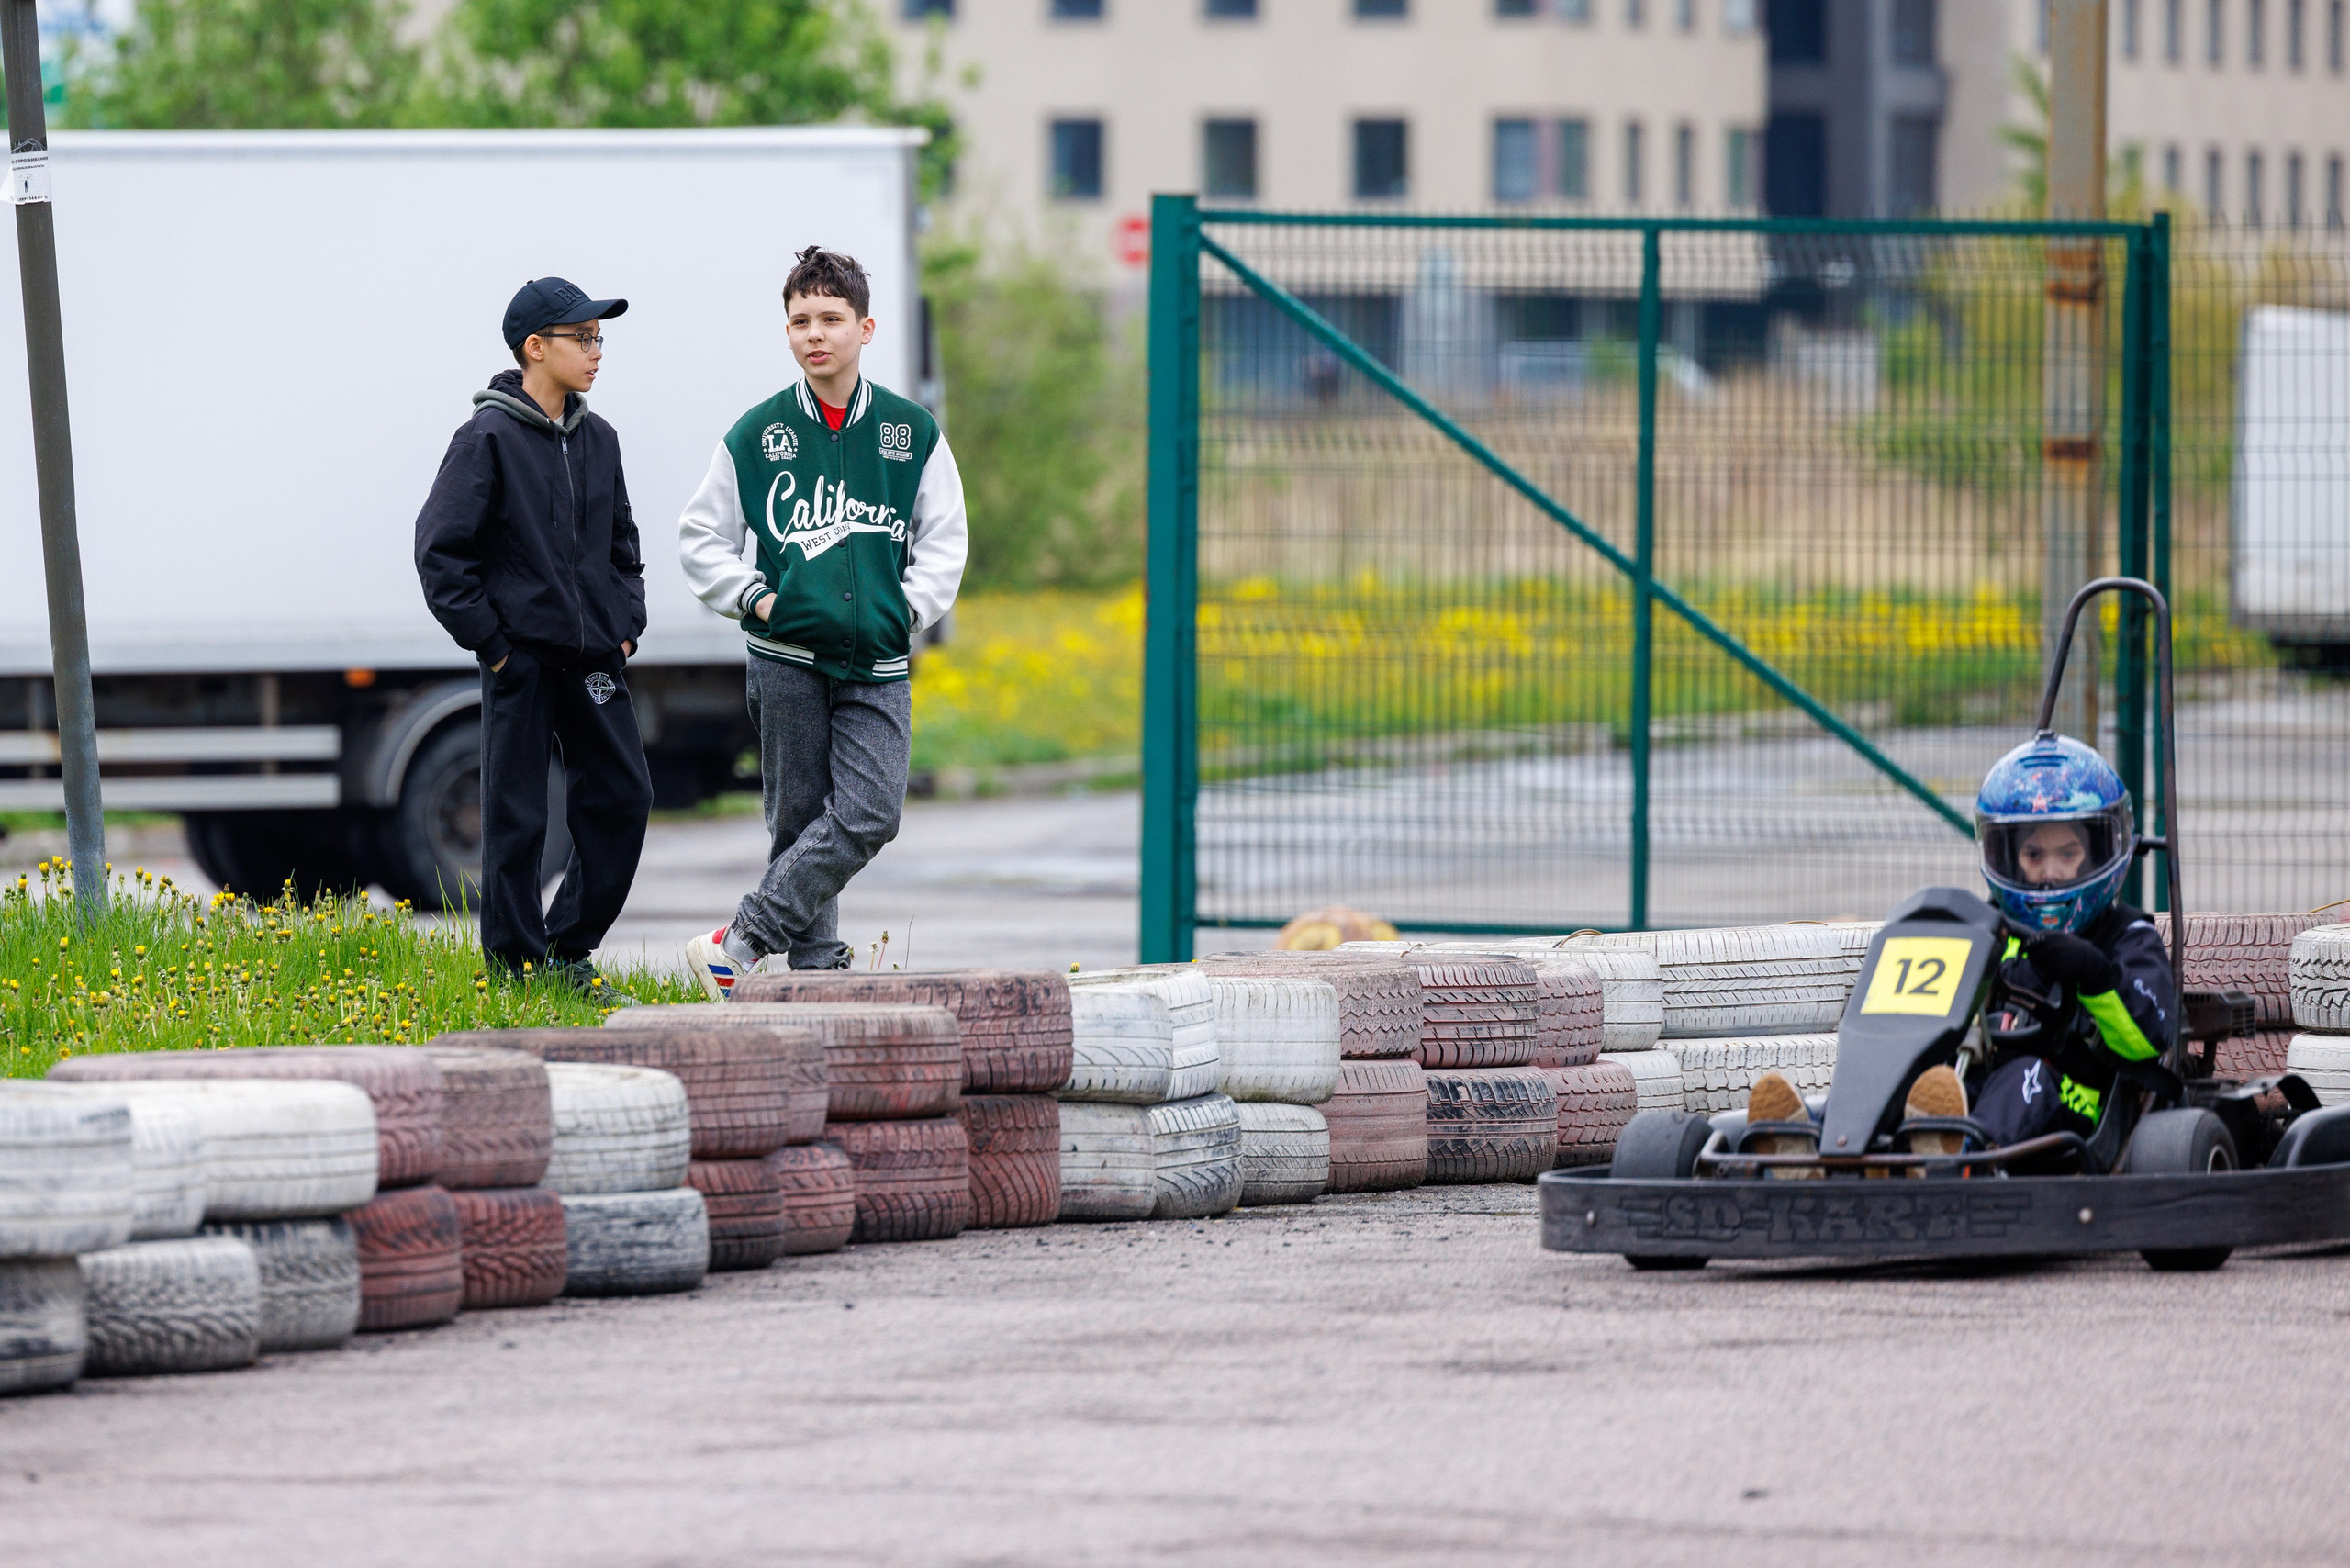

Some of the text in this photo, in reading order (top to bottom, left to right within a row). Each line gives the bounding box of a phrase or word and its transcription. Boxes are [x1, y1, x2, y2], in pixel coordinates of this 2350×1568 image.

[761, 422, 799, 447] UNIVERSITY LEAGUE
[767, 434, 793, 453] LA
[879, 422, 912, 450] 88
[765, 451, 797, 459] CALIFORNIA
[766, 470, 906, 542] California
[800, 532, 832, 551] WEST
[1894, 958, 1946, 996] 12
